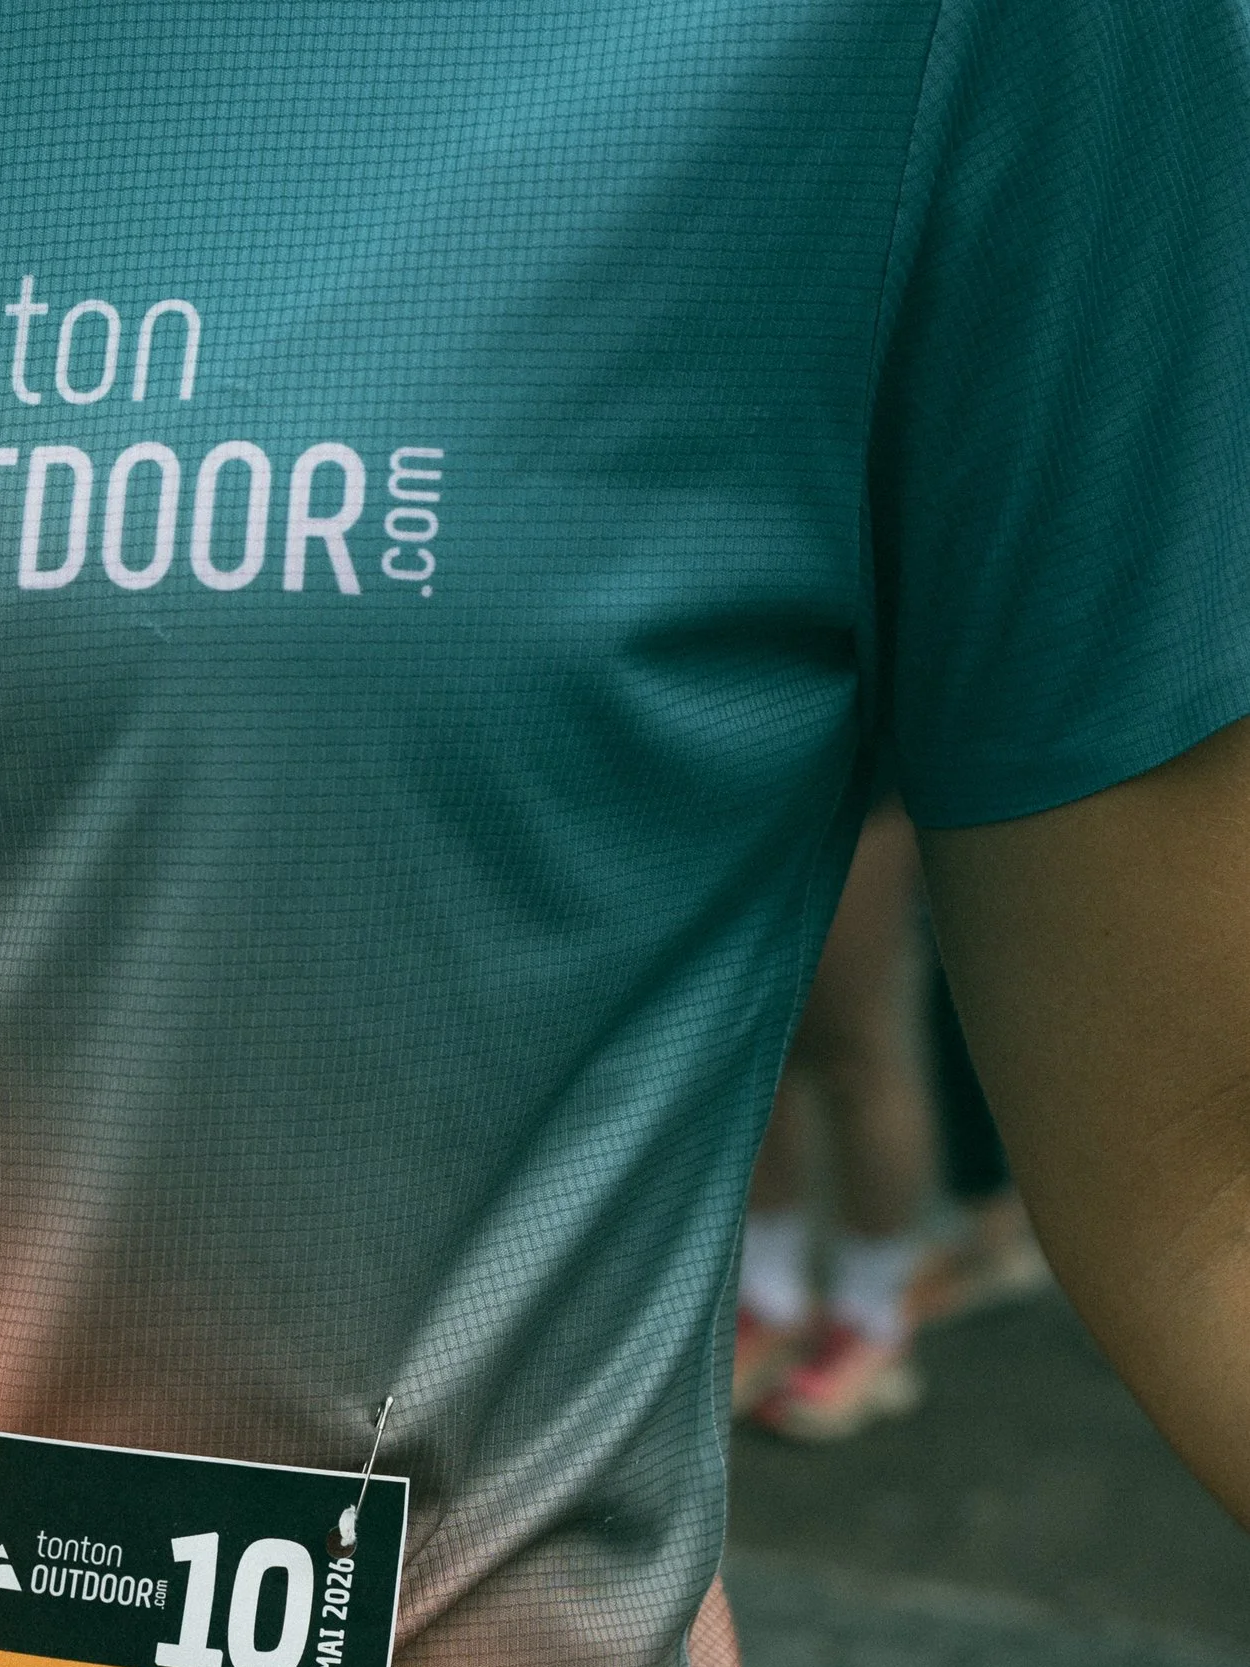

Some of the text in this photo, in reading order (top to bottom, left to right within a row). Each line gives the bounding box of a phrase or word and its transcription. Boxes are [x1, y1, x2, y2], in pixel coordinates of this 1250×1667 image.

[382, 446, 446, 599] .com
[36, 1530, 123, 1568] tonton
[30, 1563, 154, 1609] OUTDOOR
[154, 1579, 169, 1610] .com
[322, 1557, 356, 1624] 2026
